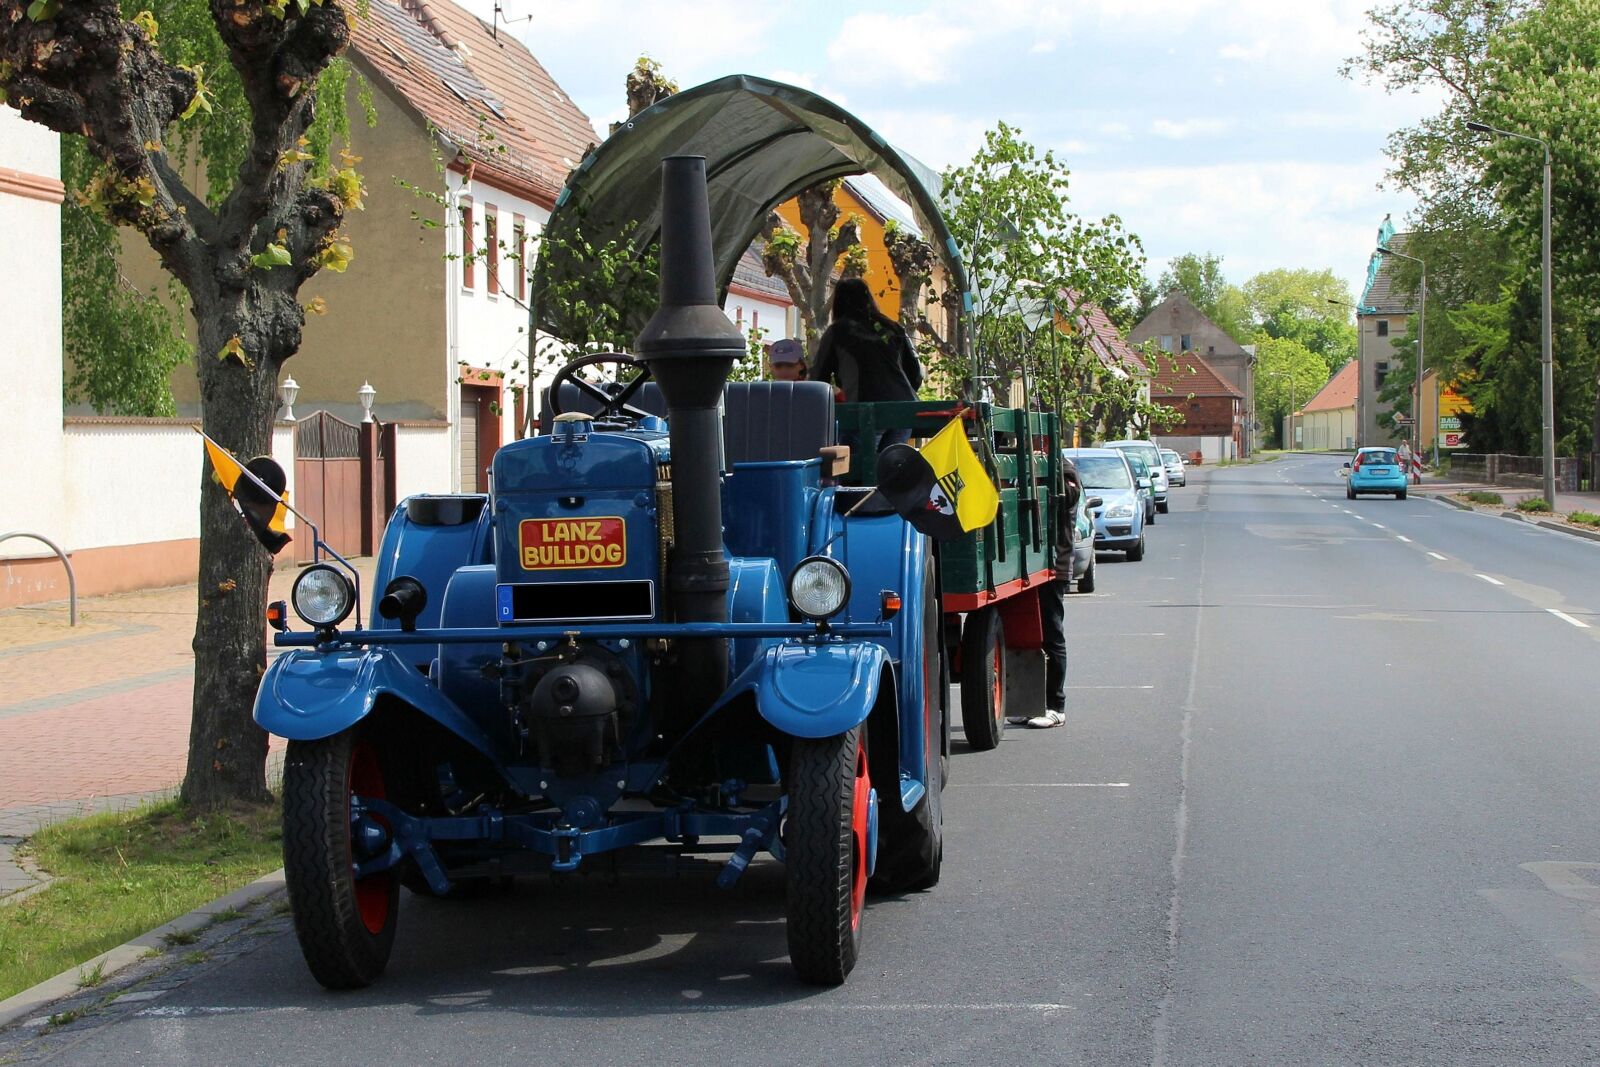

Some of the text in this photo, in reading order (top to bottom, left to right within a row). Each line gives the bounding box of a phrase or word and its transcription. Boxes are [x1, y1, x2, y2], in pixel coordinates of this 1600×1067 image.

[542, 522, 602, 542] LANZ
[524, 543, 622, 566] BULLDOG
[502, 607, 509, 615] D
